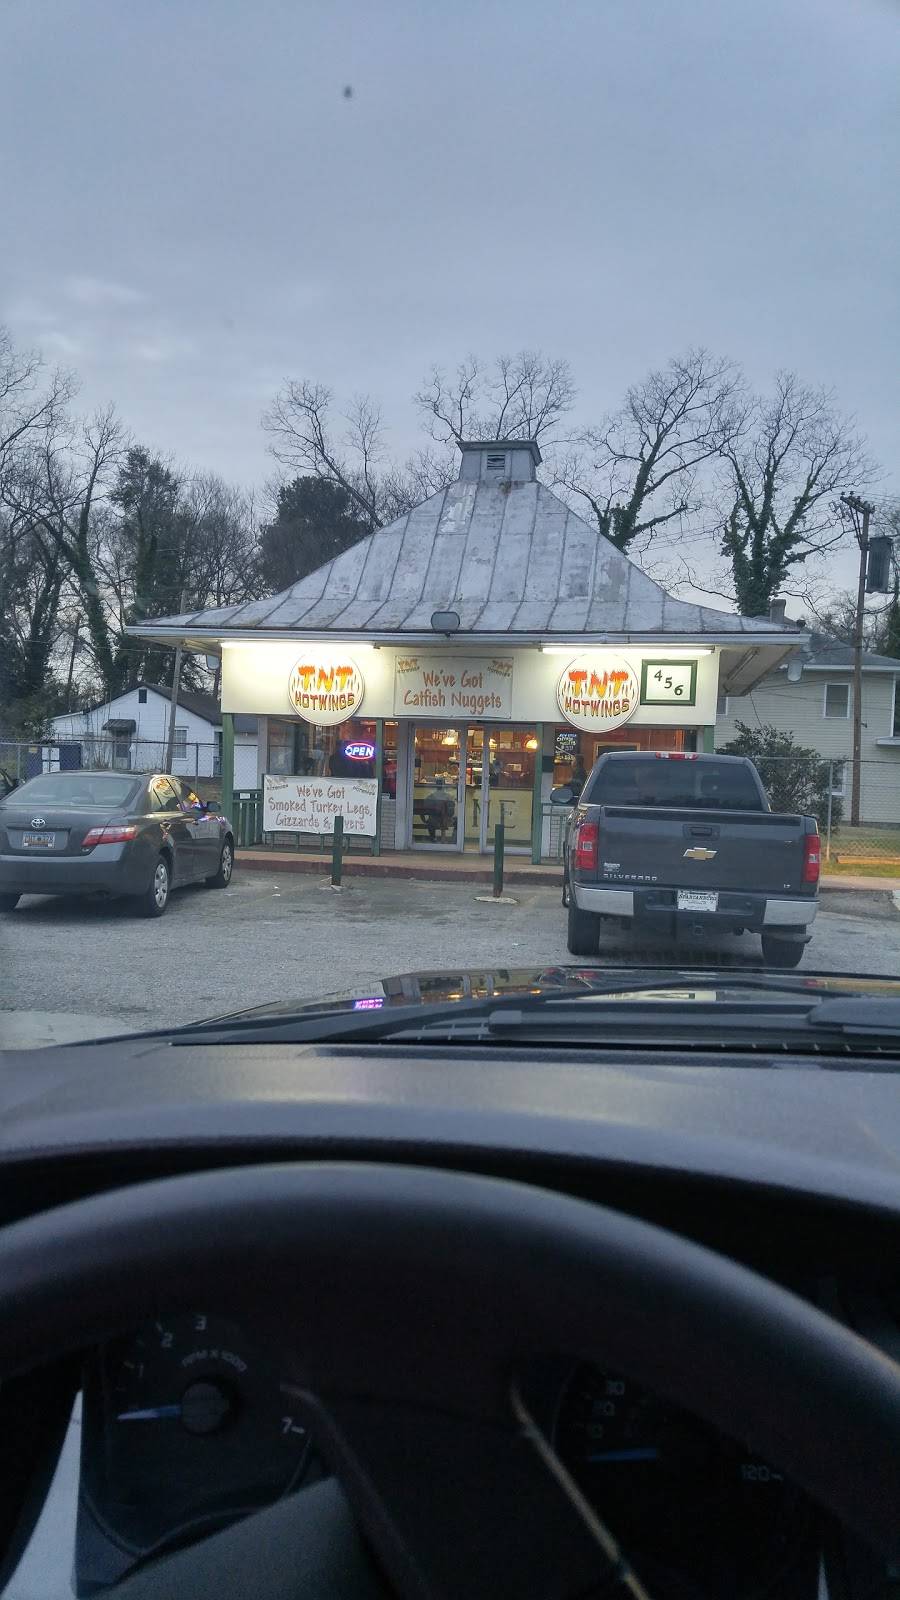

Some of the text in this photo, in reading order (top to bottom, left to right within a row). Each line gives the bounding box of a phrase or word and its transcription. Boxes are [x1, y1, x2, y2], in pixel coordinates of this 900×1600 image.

[298, 665, 353, 692] TNT
[423, 669, 483, 688] We've Got
[568, 669, 629, 698] TNT
[295, 690, 355, 711] HOTWINGS
[403, 689, 502, 715] Catfish Nuggets
[564, 696, 630, 718] HOTWINGS
[345, 746, 374, 757] OPEN
[297, 784, 323, 798] We've
[327, 785, 345, 799] Got
[268, 796, 373, 819] Smoked Turkey Legs,
[275, 813, 320, 828] Gizzards
[323, 816, 331, 830] &
[194, 1315, 207, 1331] 3
